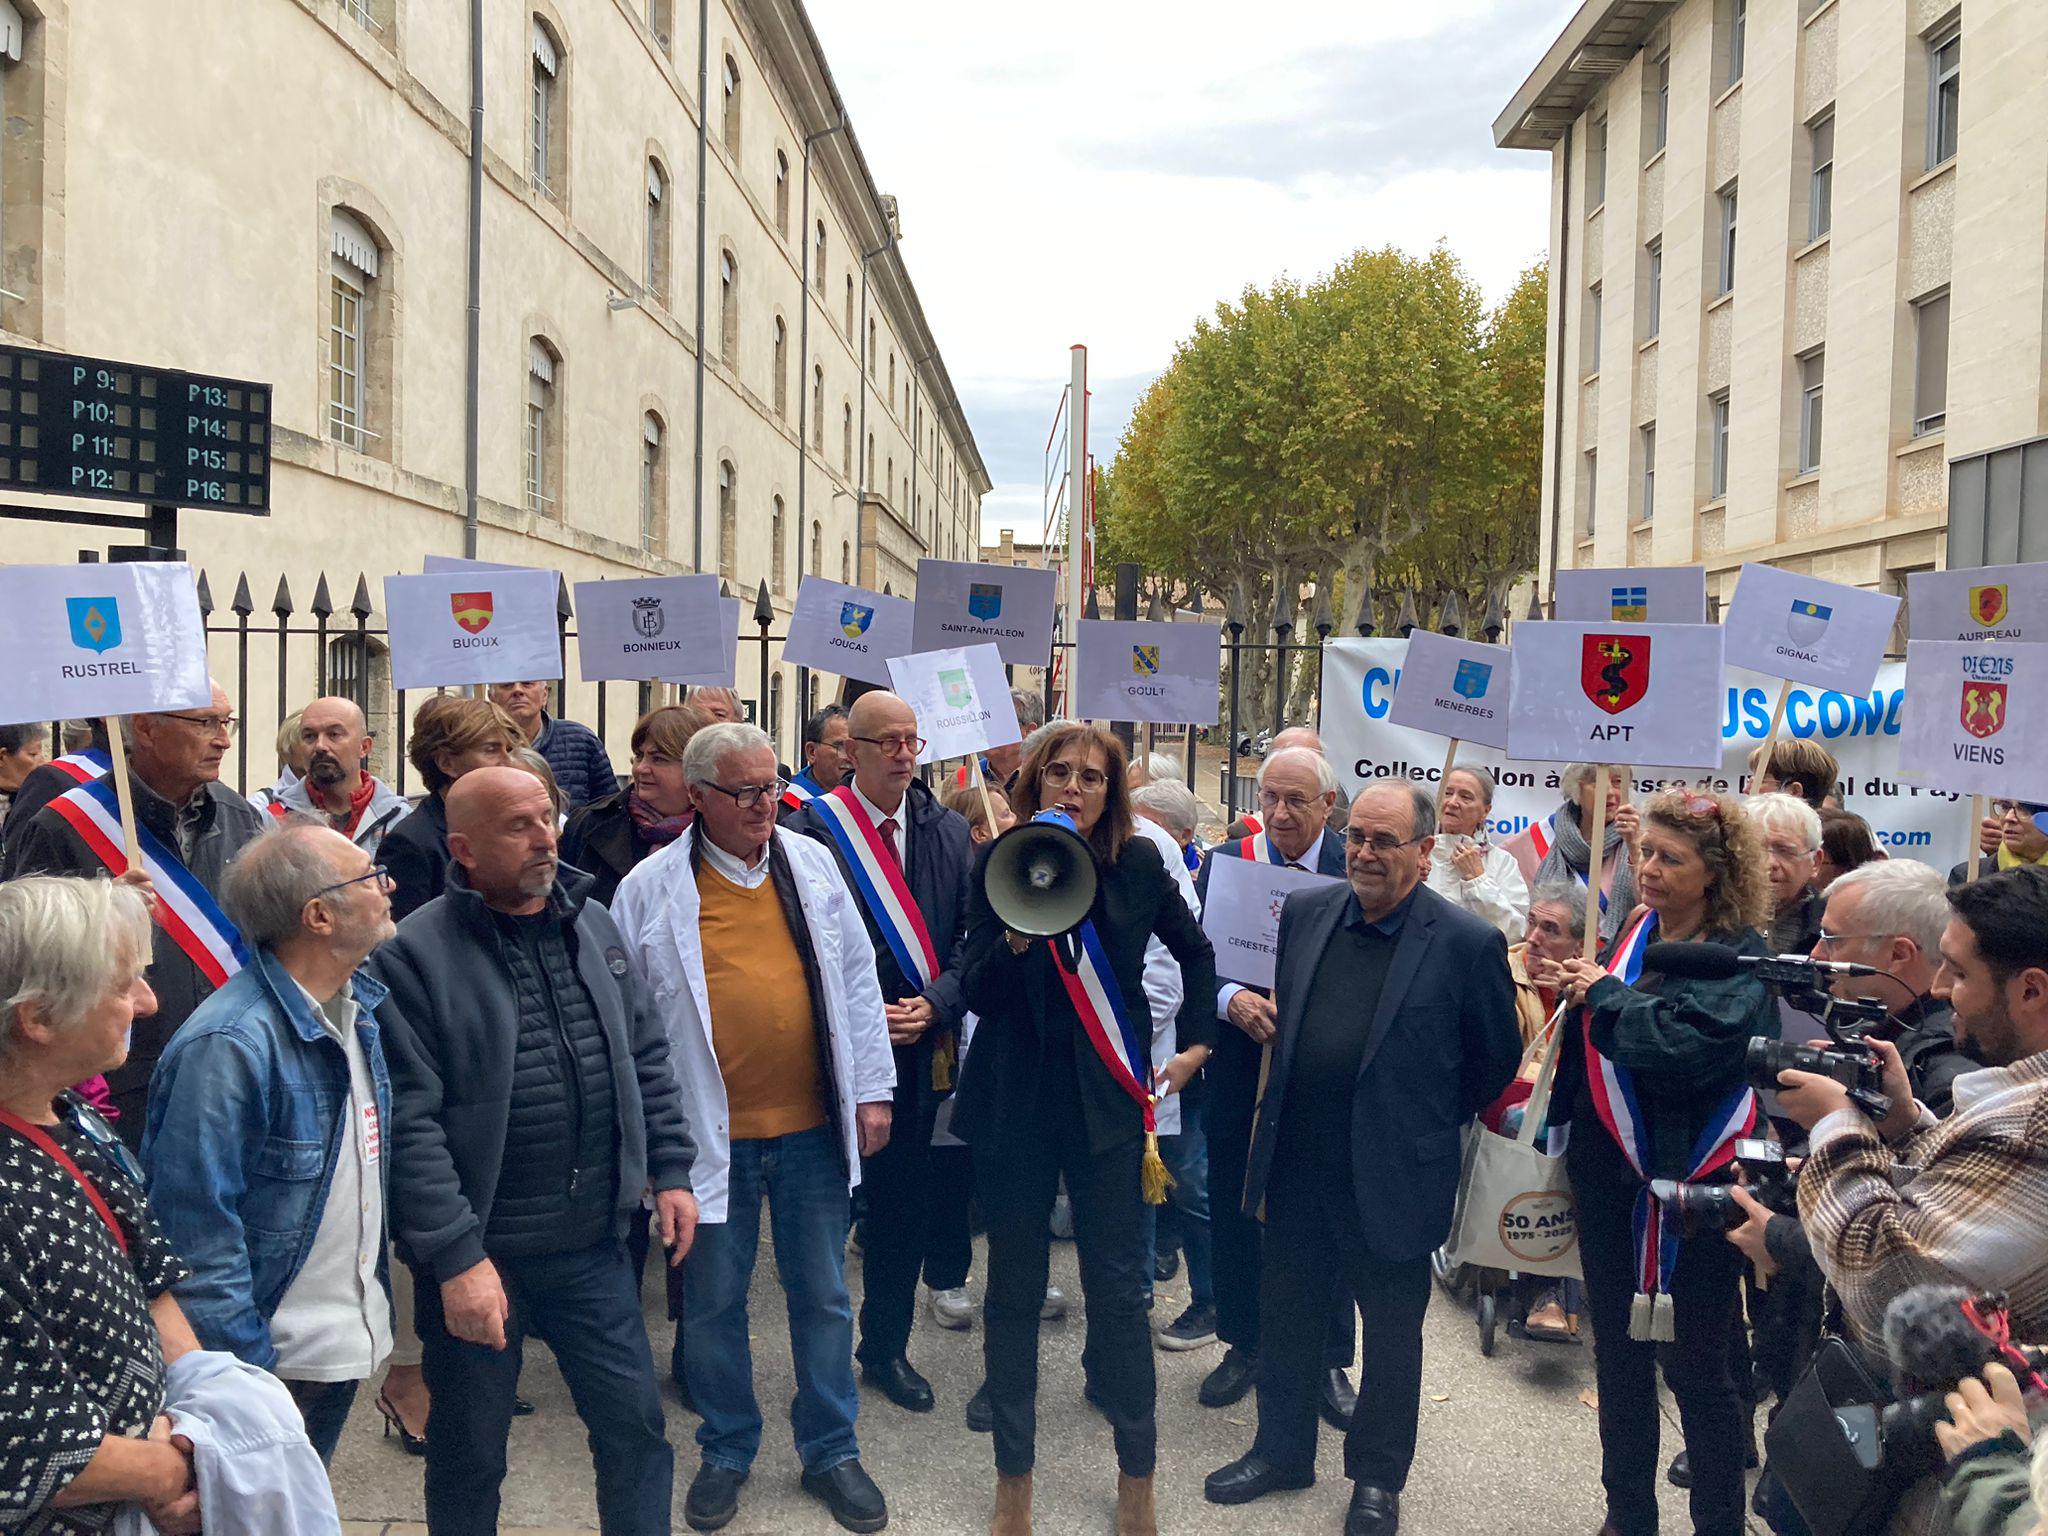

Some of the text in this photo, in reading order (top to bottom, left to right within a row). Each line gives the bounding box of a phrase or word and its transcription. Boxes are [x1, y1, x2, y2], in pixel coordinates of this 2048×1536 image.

[941, 623, 1025, 638] SAINT-PANTALEON
[1958, 629, 2021, 641] AURIBEAU
[452, 636, 498, 649] BUOUX
[623, 640, 681, 653] BONNIEUX
[829, 637, 868, 654] JOUCAS
[1776, 646, 1818, 663] GIGNAC
[61, 661, 142, 678] RUSTREL
[1128, 686, 1166, 696] GOULT
[1434, 697, 1494, 719] MENERBES
[936, 710, 991, 730] ROUSSILLON
[1589, 724, 1634, 742] APT
[1953, 742, 2005, 766] VIENS
[1354, 759, 1441, 782] Collec
[1545, 770, 1561, 789] à
[1864, 777, 1898, 796] du
[1228, 936, 1278, 955] CERESTE-E
[1502, 1212, 1530, 1228] 50
